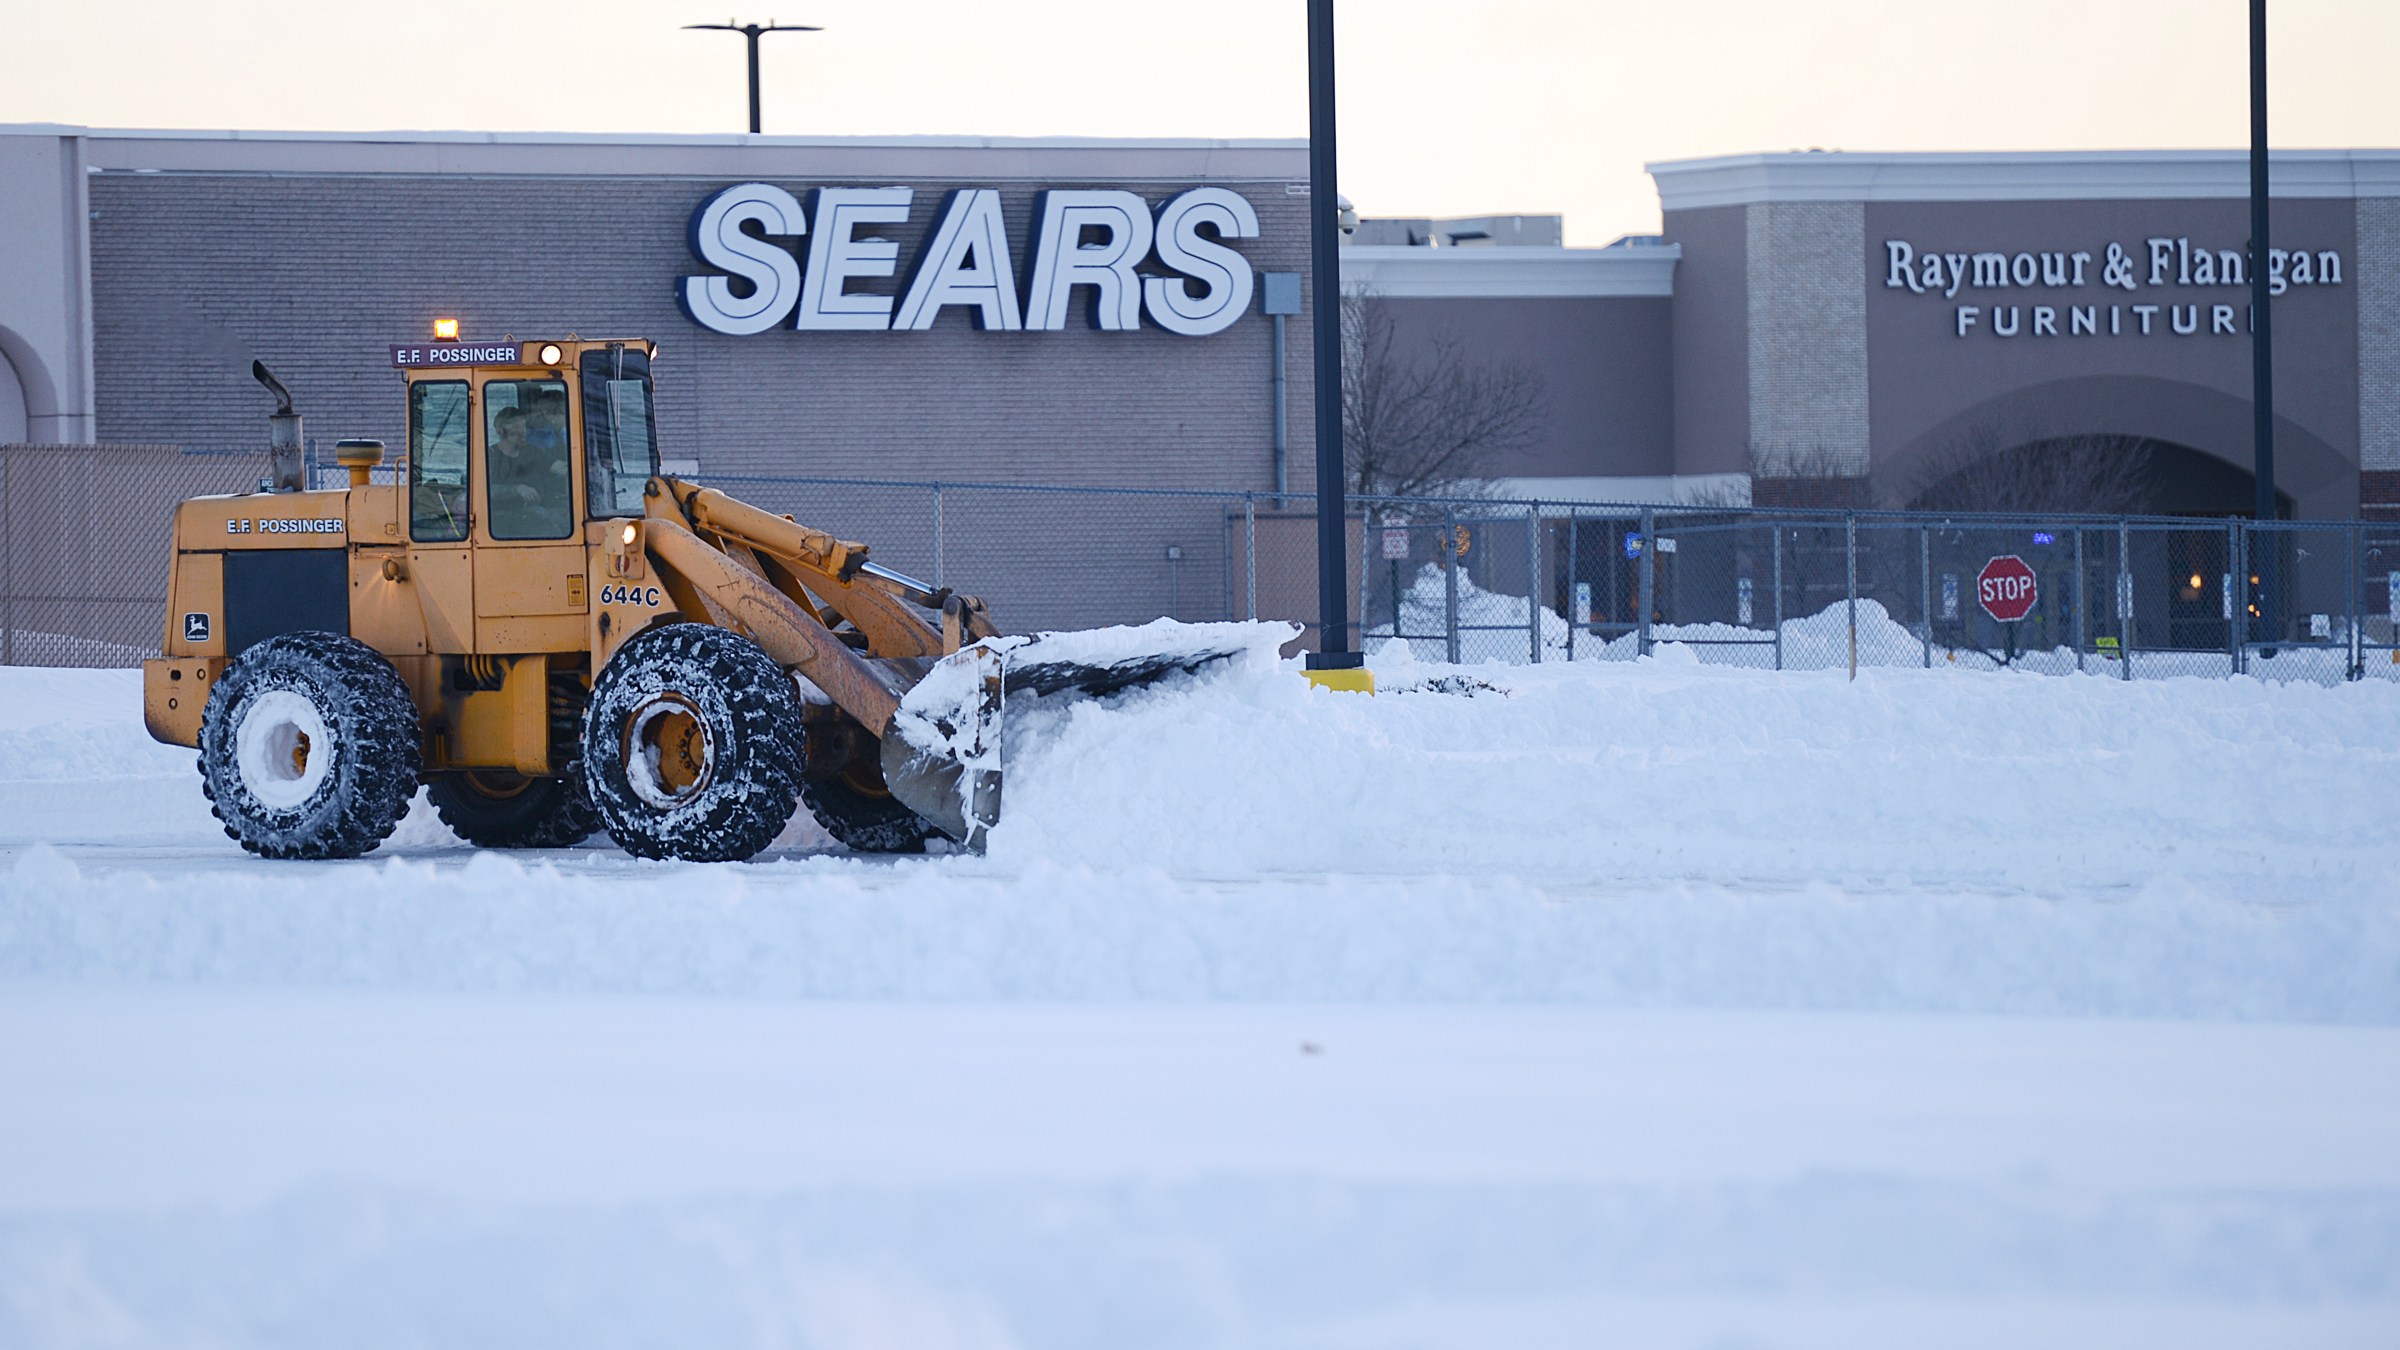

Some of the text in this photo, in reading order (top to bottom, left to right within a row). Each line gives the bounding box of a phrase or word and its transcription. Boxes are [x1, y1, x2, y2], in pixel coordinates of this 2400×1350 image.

[682, 183, 1260, 336] SEARS
[1885, 236, 2343, 299] Raymour & Flangan
[1957, 304, 2254, 337] FURNITUR
[397, 347, 516, 364] E.F. POSSINGER
[226, 518, 344, 534] E.F. POSSINGER
[600, 583, 660, 608] 644C
[1982, 575, 2032, 602] STOP
